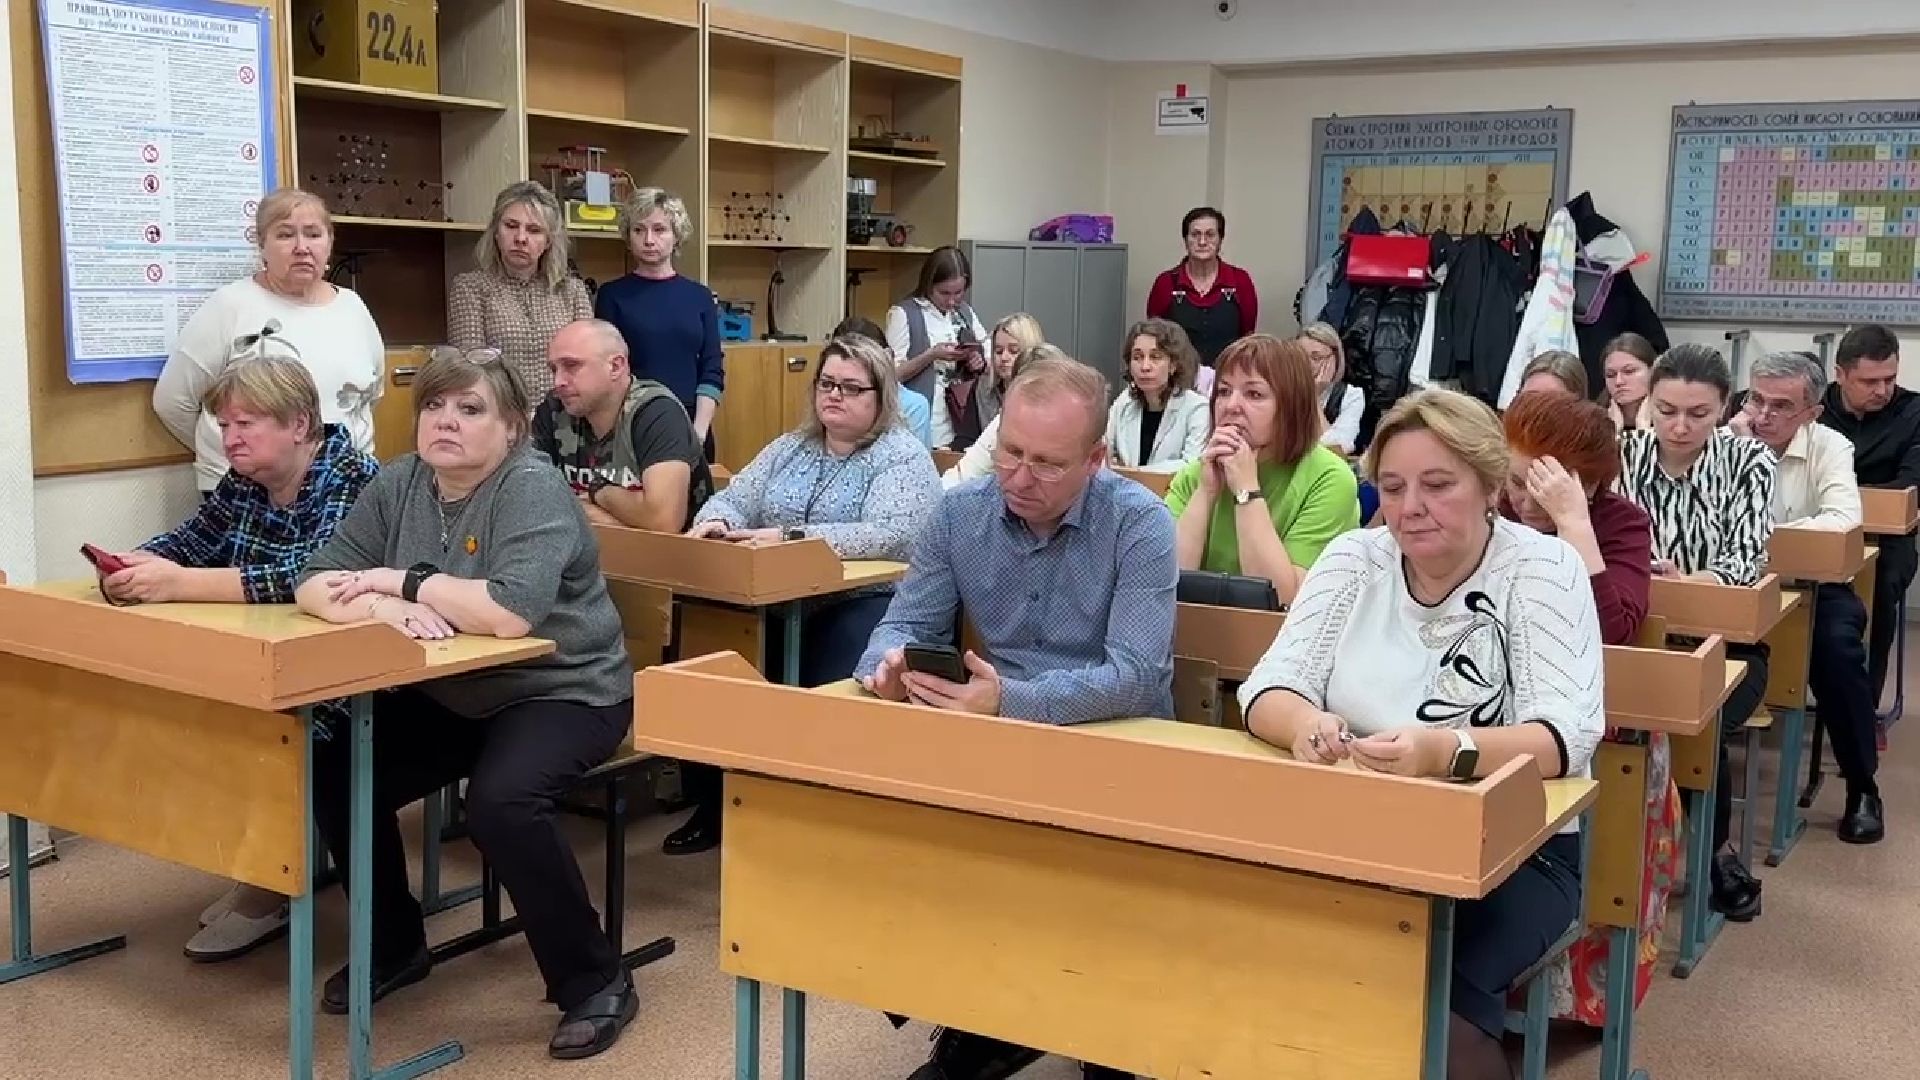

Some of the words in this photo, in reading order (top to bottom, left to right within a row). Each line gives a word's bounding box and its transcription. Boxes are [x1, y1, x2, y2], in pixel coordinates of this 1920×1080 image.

[1325, 138, 1374, 150] АТОМОВ
[1384, 135, 1452, 149] ЭЛЕМЕНТОВ
[1488, 132, 1558, 146] ПЕРИОДОВ
